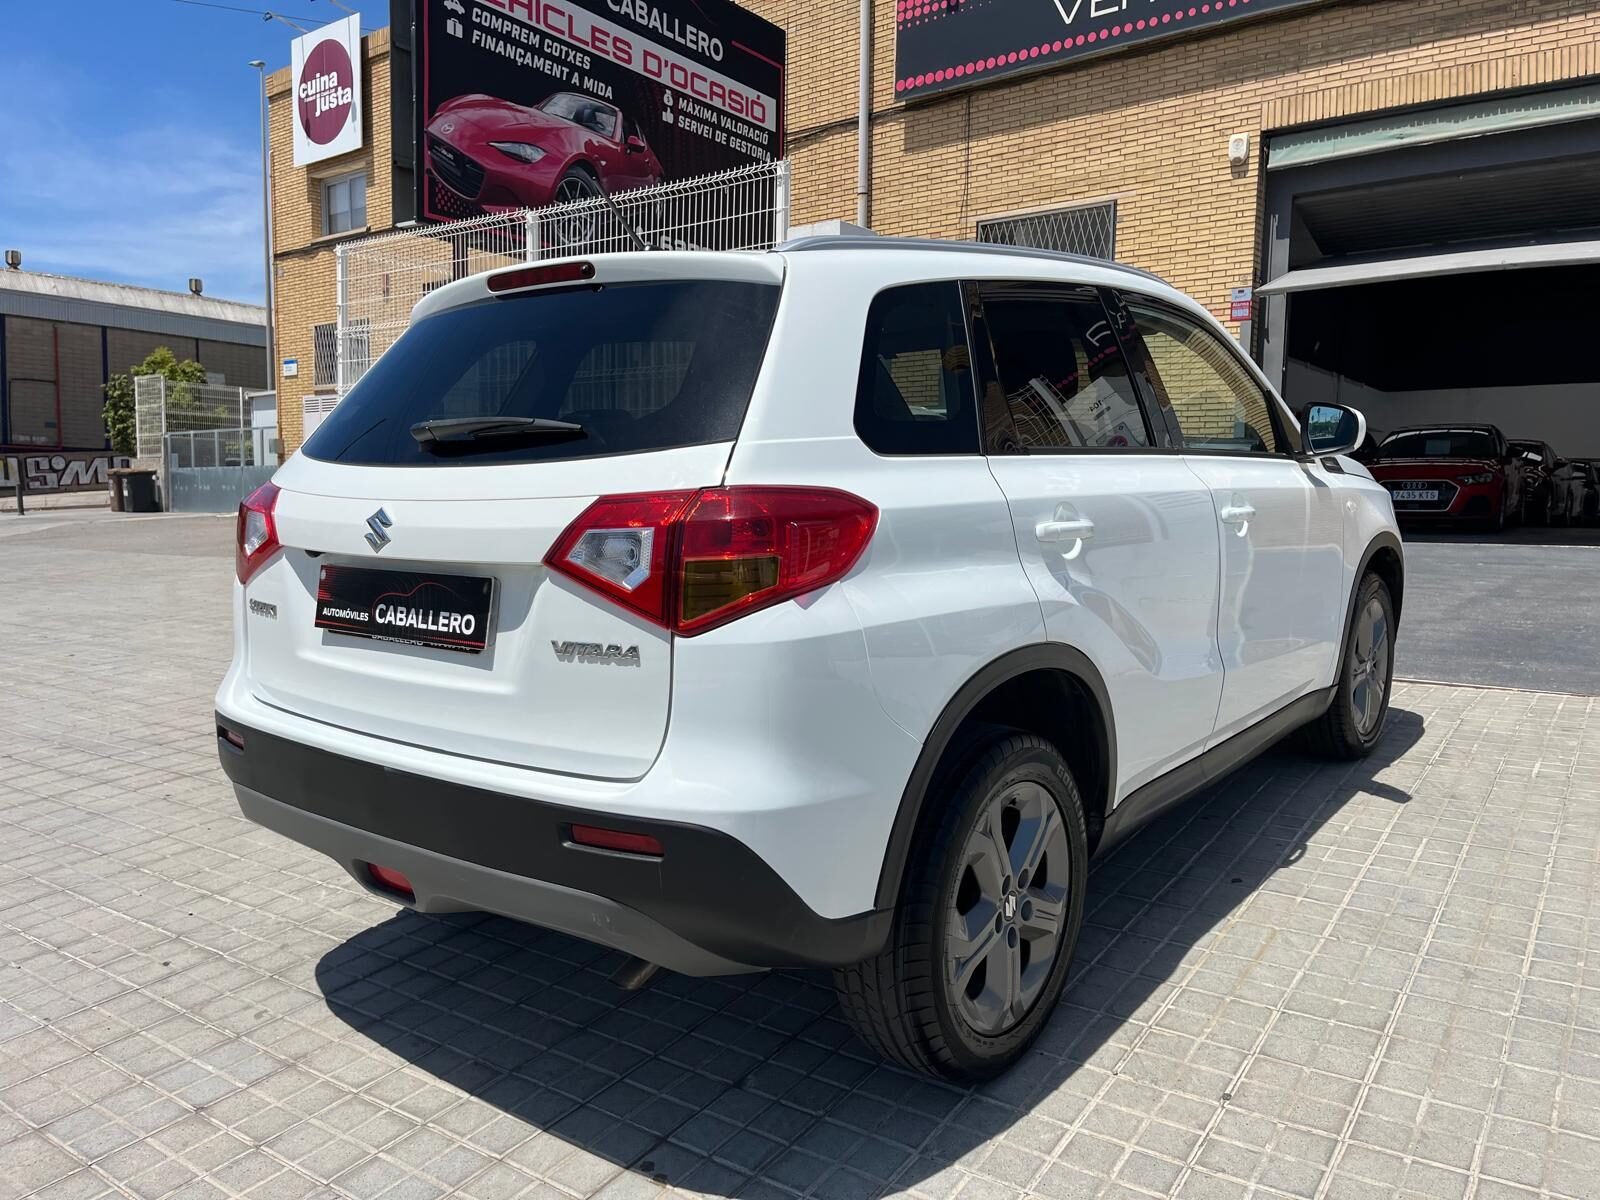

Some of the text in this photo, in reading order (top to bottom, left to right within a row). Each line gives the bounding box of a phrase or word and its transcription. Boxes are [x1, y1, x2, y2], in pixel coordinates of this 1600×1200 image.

[472, 7, 591, 70] COMPREM COTXES
[485, 0, 632, 66] HICLES
[607, 0, 723, 62] CABALLERO
[472, 30, 613, 100] FINANÇAMENT A MIDA
[299, 71, 338, 99] cuina
[315, 86, 352, 117] justa
[678, 115, 771, 161] SERVEI DE GESTORIA
[720, 114, 769, 145] VALORACIÓ
[1418, 491, 1436, 499] KTS
[322, 603, 476, 636] AUTOMÓVILES CABALLERO
[551, 640, 641, 661] VITARA
